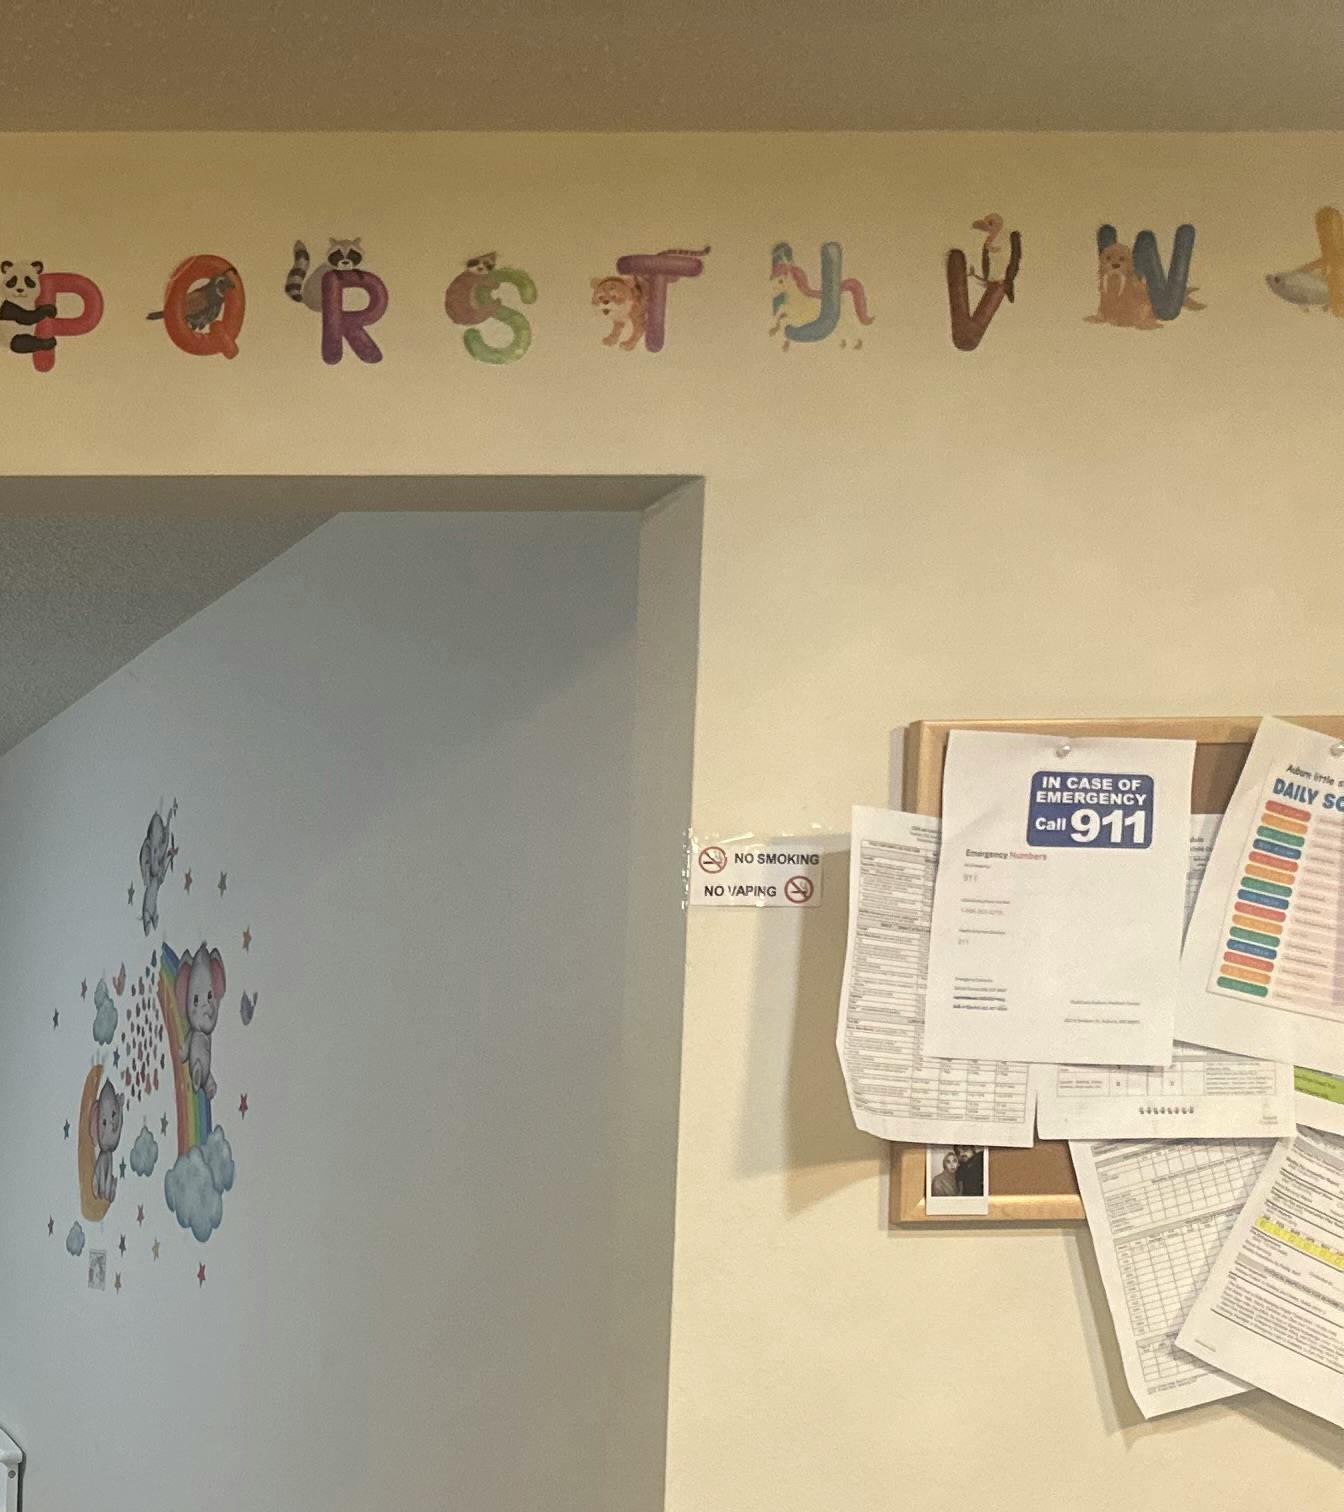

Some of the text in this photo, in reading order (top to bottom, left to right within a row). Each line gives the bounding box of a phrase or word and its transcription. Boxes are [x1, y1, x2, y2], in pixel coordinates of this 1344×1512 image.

[32, 271, 105, 373] P
[163, 253, 247, 360] Q
[321, 269, 390, 365] R
[461, 265, 538, 365] S
[616, 243, 704, 353] T
[947, 229, 1023, 352] V
[1099, 223, 1197, 321] W
[1042, 776, 1142, 791] IN CASE OF
[1273, 777, 1319, 805] DAILY
[1035, 791, 1147, 806] EMERGENCY
[1035, 808, 1146, 844] Call 911
[734, 853, 820, 865] NO SMOKING
[965, 849, 1047, 861] Emergency Numbers
[704, 885, 777, 897] NO VAPING
